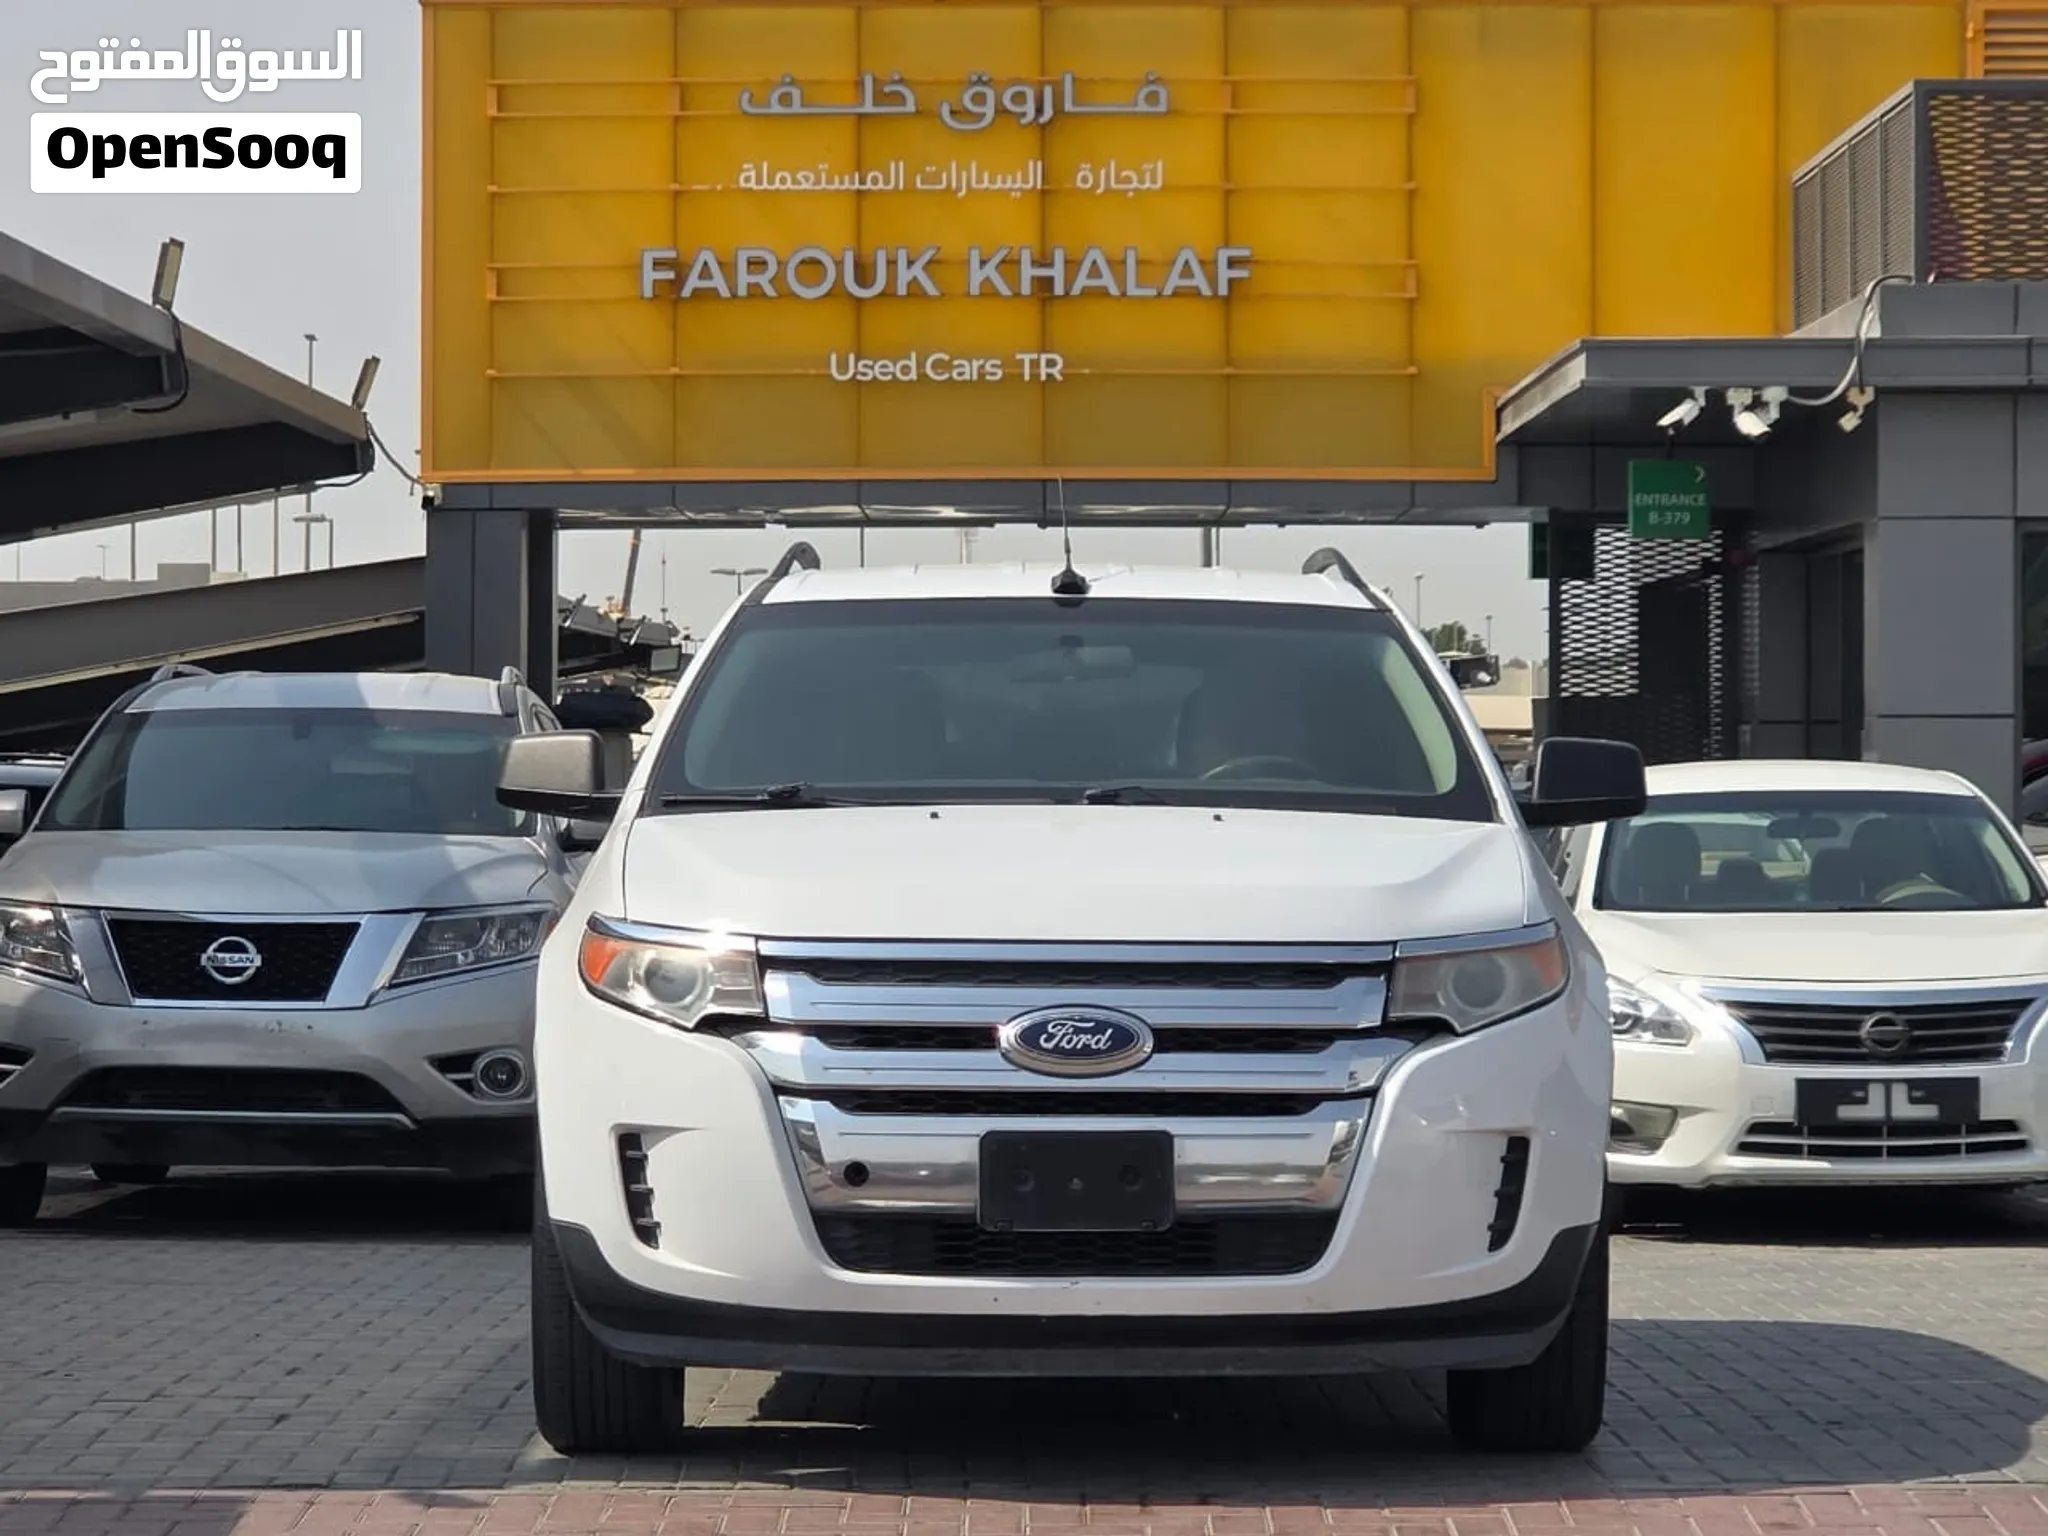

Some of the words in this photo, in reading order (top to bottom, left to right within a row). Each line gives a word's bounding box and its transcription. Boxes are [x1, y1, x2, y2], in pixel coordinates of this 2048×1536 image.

[738, 71, 918, 115] خلف
[939, 71, 1170, 131] فاروق
[738, 159, 904, 191] المستعملة
[1075, 159, 1164, 198] لتجارة
[639, 245, 941, 300] FAROUK
[967, 245, 1254, 298] KHALAF
[828, 351, 917, 382] Used
[924, 352, 1003, 382] Cars
[1015, 352, 1065, 382] TR
[1635, 493, 1707, 507] ENTRANCE
[1648, 510, 1692, 525] B-379
[206, 954, 255, 965] NISSAN
[1039, 1019, 1113, 1051] Ford
